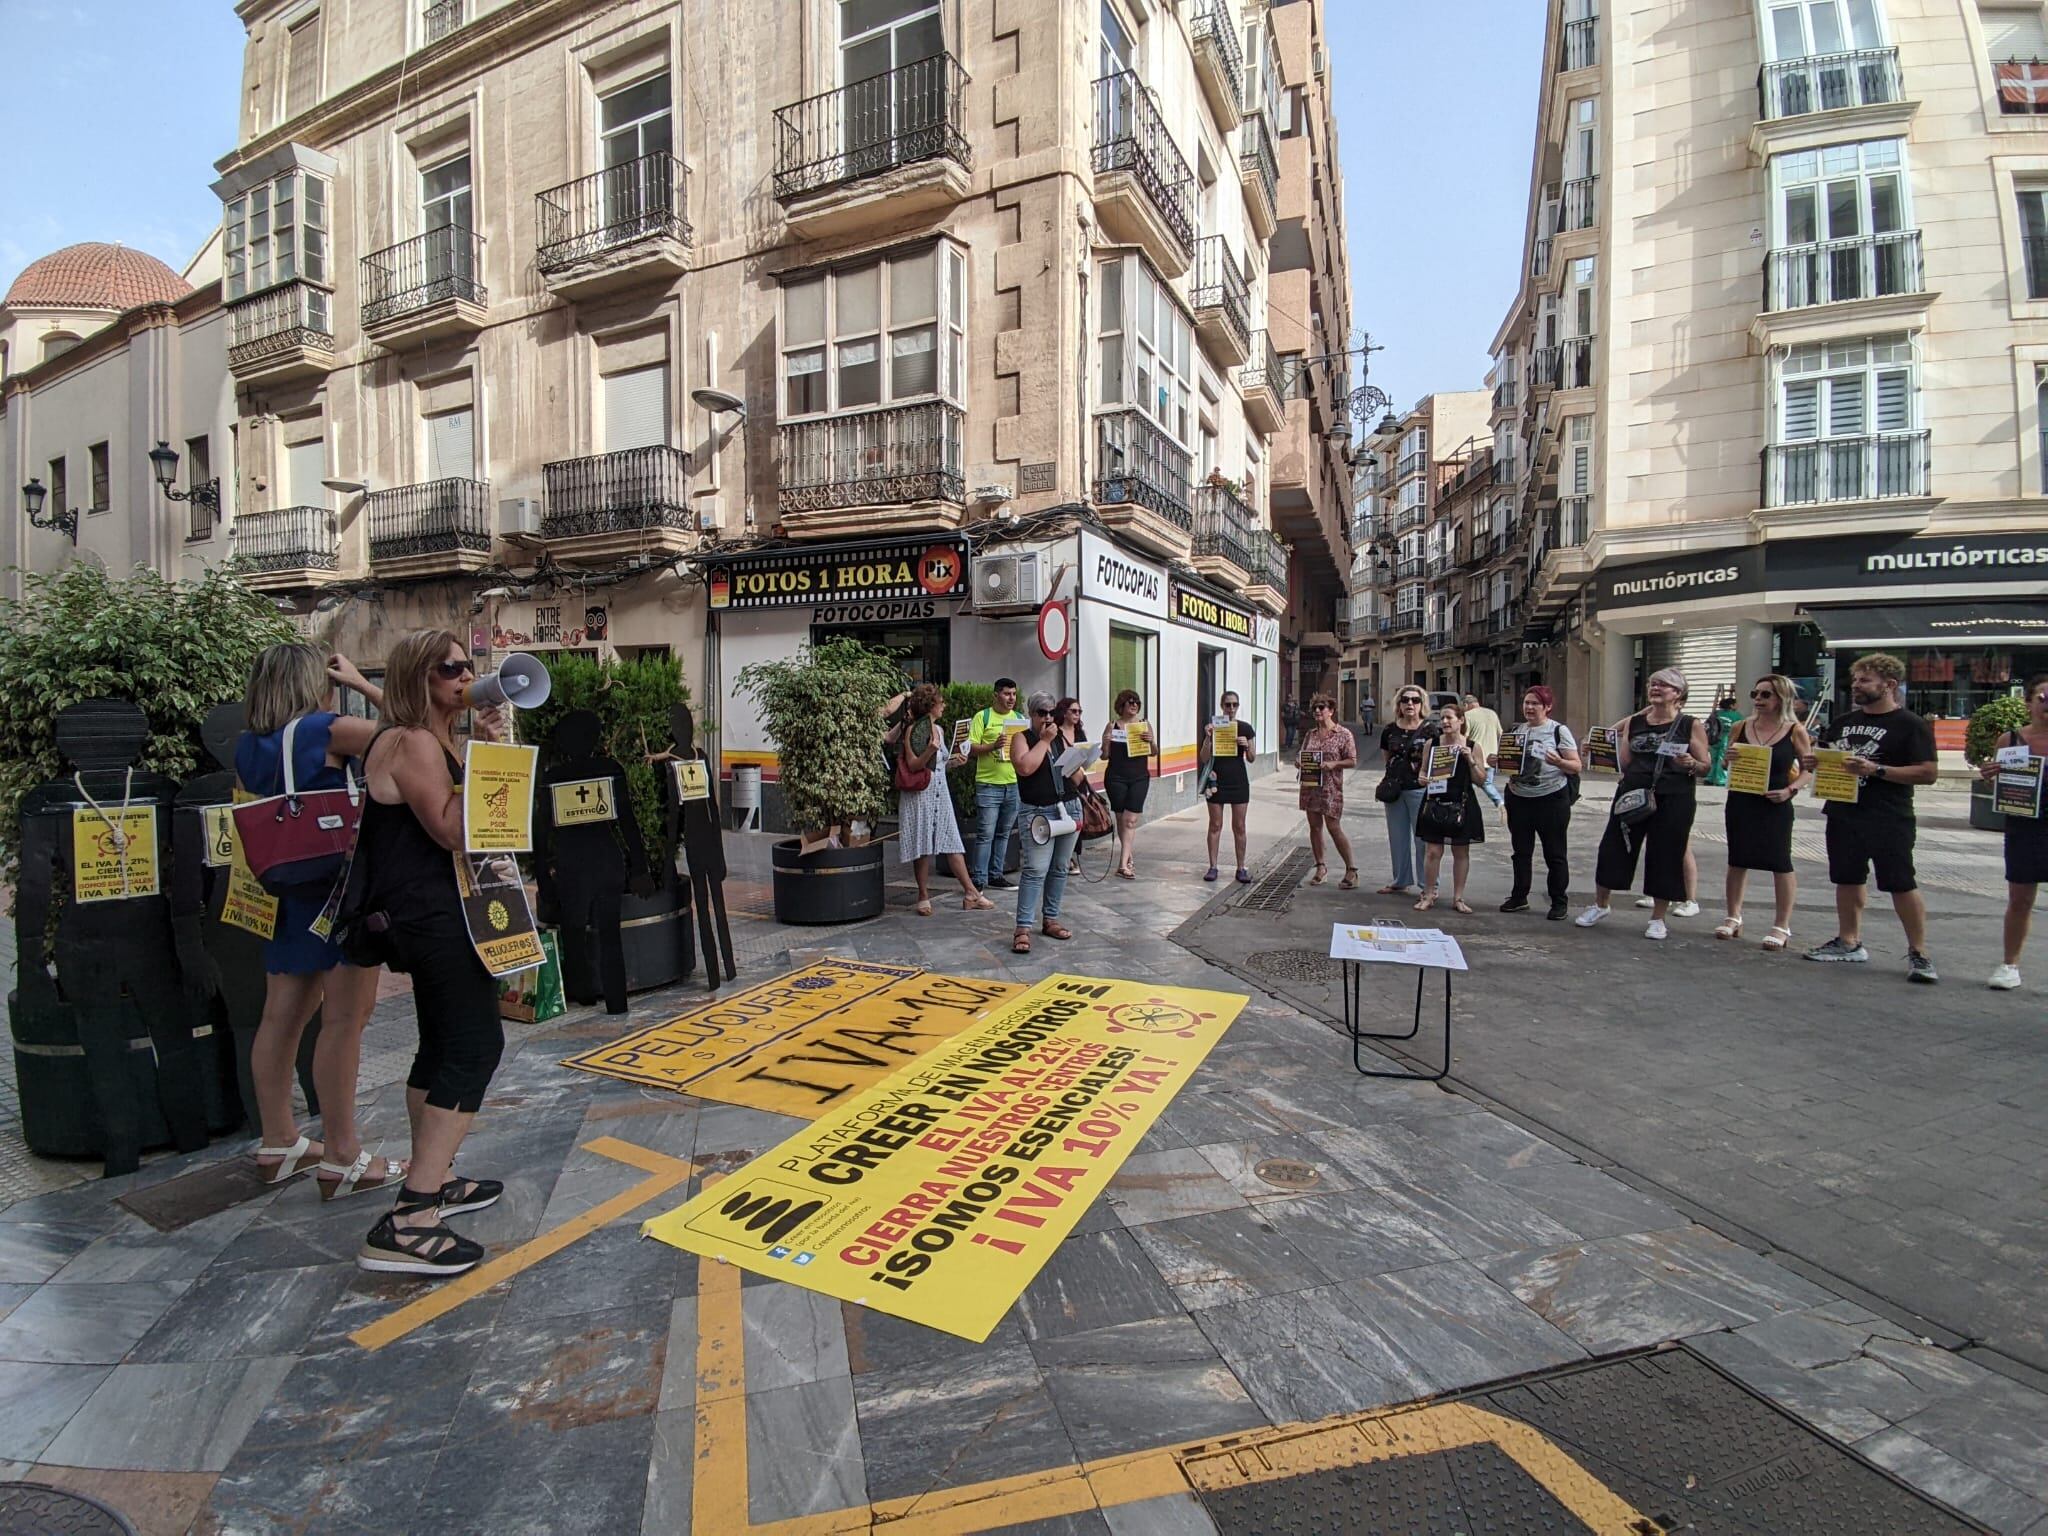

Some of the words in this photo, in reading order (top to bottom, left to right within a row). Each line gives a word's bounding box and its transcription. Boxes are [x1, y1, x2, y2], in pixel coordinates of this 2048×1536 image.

[735, 569, 811, 594] FOTOS
[818, 569, 830, 589] 1
[836, 561, 913, 588] HORA
[924, 559, 953, 579] Pix
[1096, 554, 1159, 601] FOTOCOPIAS
[536, 606, 560, 625] ENTRE
[812, 601, 935, 624] FOTOCOPIAS
[1181, 593, 1218, 624] FOTOS
[1219, 609, 1225, 627] 1
[1225, 610, 1249, 635] HORA
[533, 624, 560, 643] HORAS
[1841, 725, 1888, 741] BARBER
[96, 860, 112, 868] IVA
[894, 978, 1007, 1015] 10%
[888, 1014, 925, 1029] AL
[778, 1089, 916, 1172] PLATAFORMA
[908, 1071, 943, 1087] DE
[933, 1036, 993, 1071] IMAGEN
[985, 998, 1053, 1042] PERSONAL
[808, 1103, 951, 1185] CREER
[924, 1073, 990, 1103] EN
[961, 999, 1088, 1074] NOSOTROS
[915, 1126, 977, 1153] EL
[954, 1090, 1019, 1122] IVA
[999, 1067, 1048, 1089] AL
[1027, 1036, 1083, 1065] 21%
[1061, 1101, 1141, 1159] 10%
[839, 1181, 961, 1266] CIERRA
[936, 1093, 1052, 1179] NUESTROS
[1035, 1042, 1110, 1092] CENTROS
[869, 1164, 1020, 1291] ¡SOMOS
[1002, 1046, 1142, 1162] ESENCIALES!
